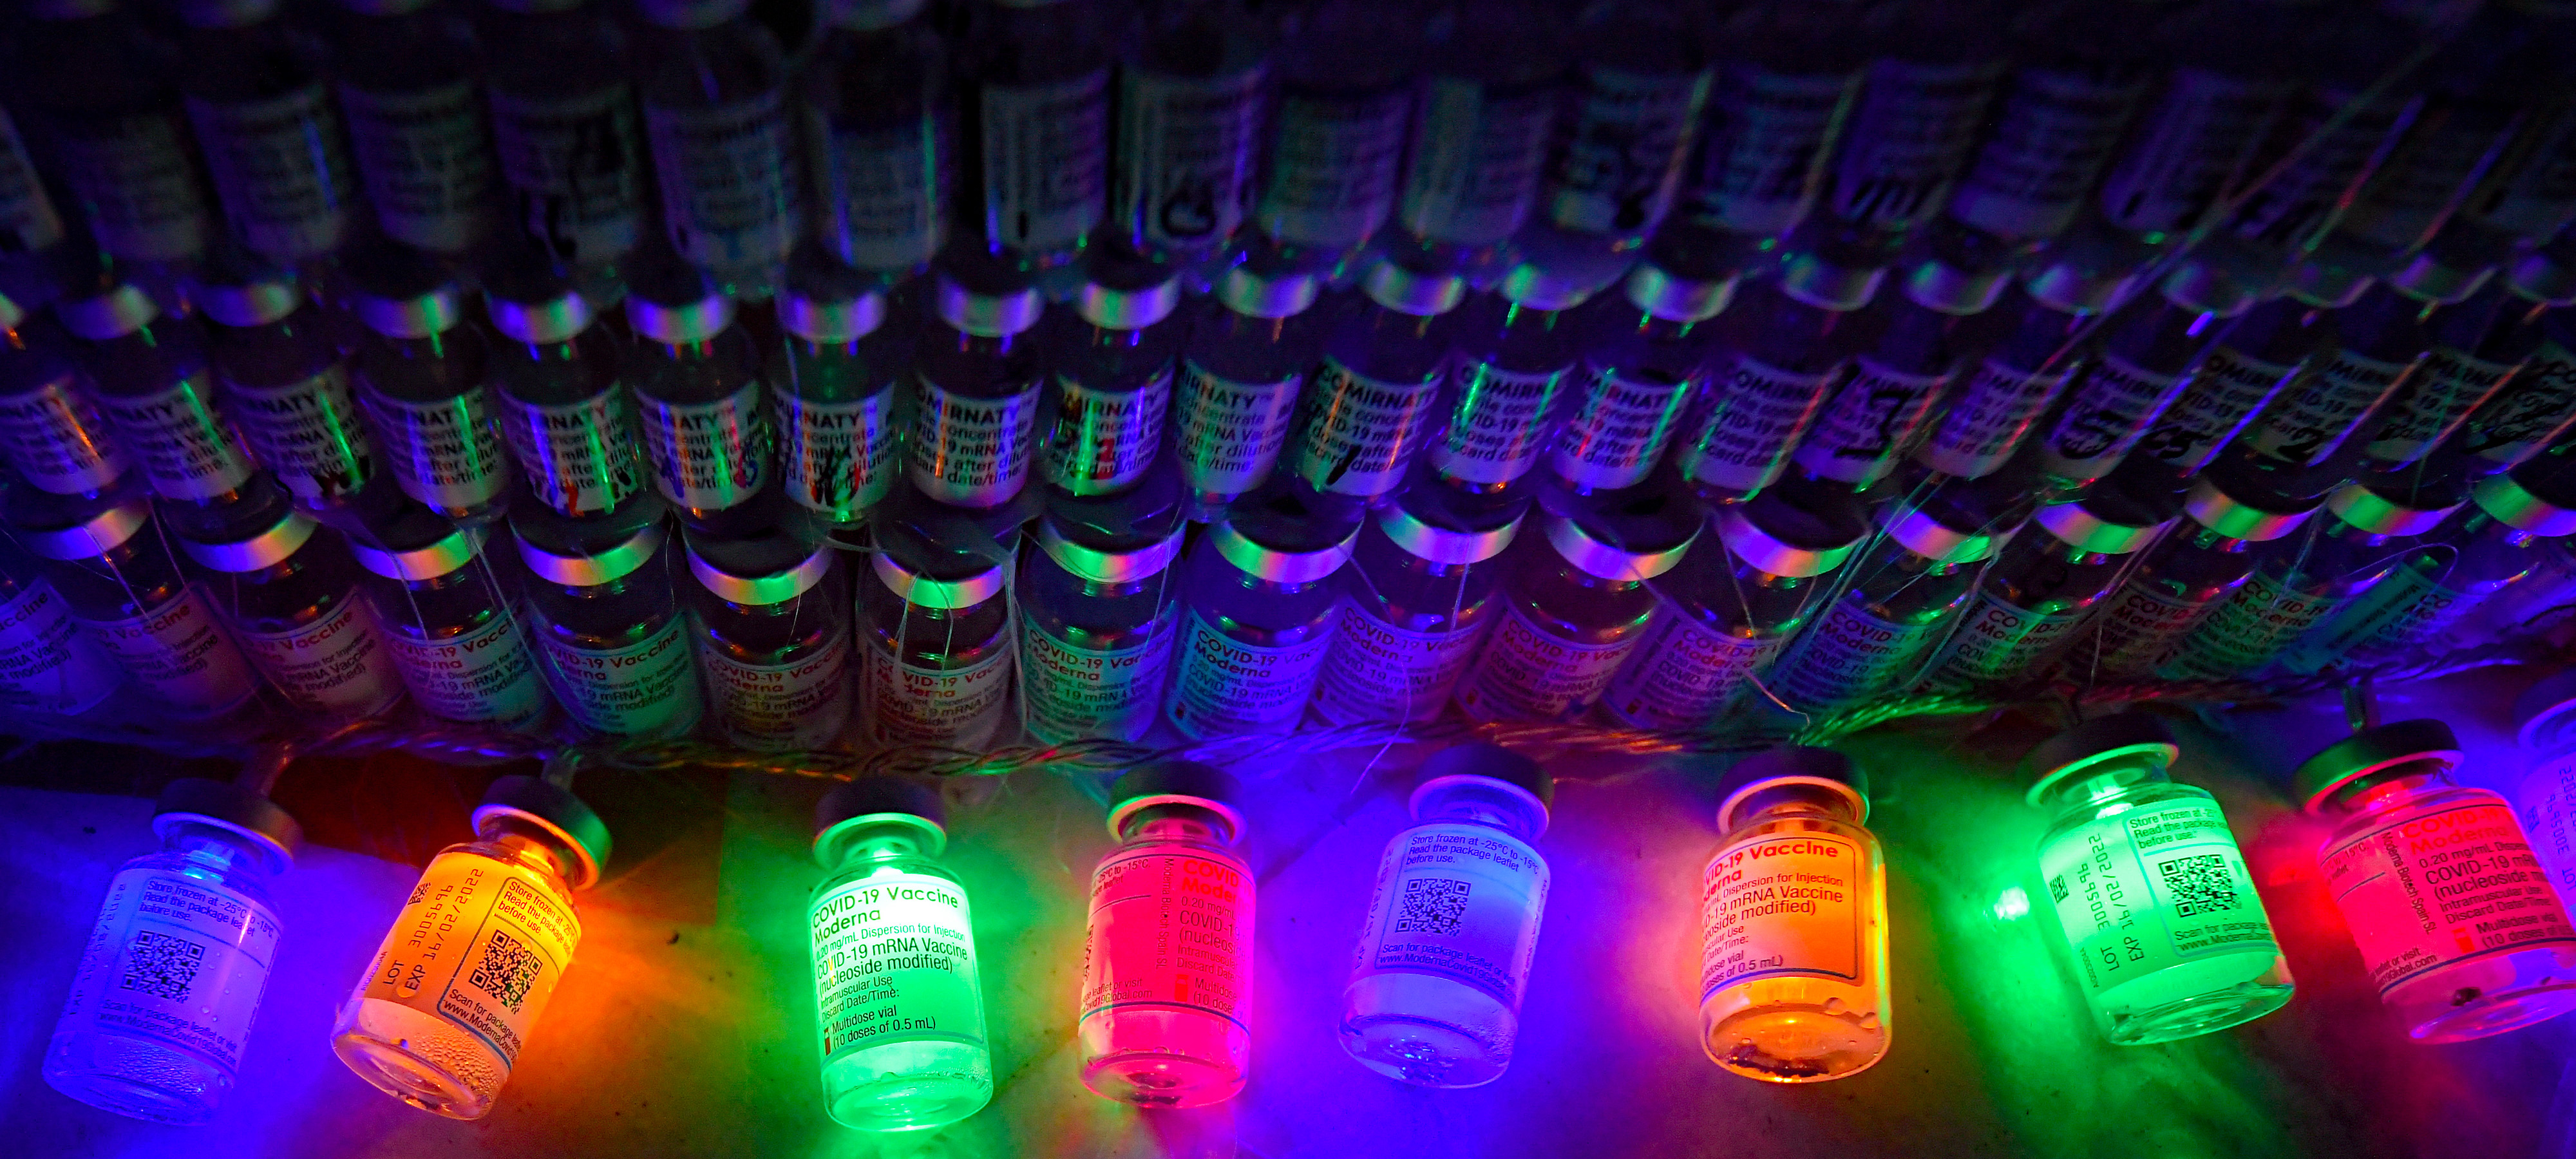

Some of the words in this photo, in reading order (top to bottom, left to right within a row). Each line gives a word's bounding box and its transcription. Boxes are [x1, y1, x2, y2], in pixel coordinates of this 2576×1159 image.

[279, 612, 352, 650] Vaccine
[610, 630, 679, 668] Vaccine
[1030, 630, 1103, 669] COVID-19
[1195, 642, 1271, 677] Moderna
[1198, 630, 1277, 666] COVID-19
[2130, 816, 2158, 829] Store
[2134, 827, 2163, 838] Read
[1408, 844, 1430, 855] Read
[1433, 843, 1448, 852] the
[1450, 845, 1491, 862] package
[1412, 836, 1434, 846] Store
[1437, 834, 1466, 845] frozen
[1468, 837, 1479, 846] at
[1481, 840, 1508, 856] -25°C
[1510, 848, 1518, 860] to
[1750, 841, 1838, 860] Vaccine
[2139, 833, 2173, 849] before
[1124, 859, 1150, 871] -15°C.
[1406, 855, 1434, 865] before
[1436, 854, 1456, 863] use.
[2419, 853, 2448, 869] 0.20
[2425, 856, 2510, 885] COVID-19
[1162, 858, 1174, 895] Moderna
[1723, 876, 1773, 898] Dispersion
[1777, 873, 1793, 883] for
[1796, 872, 1843, 887] Injection
[2434, 871, 2529, 901] (nucleoside
[143, 891, 168, 903] Read
[170, 896, 185, 908] the
[188, 901, 229, 923] package
[147, 880, 173, 894] Store
[174, 885, 206, 902] frozen
[207, 896, 219, 905] at
[220, 901, 247, 918] -25°C
[509, 881, 532, 900] Store
[533, 896, 555, 919] frozen
[556, 916, 564, 926] at
[813, 889, 880, 928] COVID-19
[887, 887, 958, 908] Vaccine
[1181, 896, 1204, 909] 0.20
[1207, 902, 1235, 920] mg/mL
[1730, 887, 1776, 910] mRNA
[1779, 885, 1843, 903] Vaccine
[1741, 900, 1816, 921] modified)
[139, 902, 170, 916] before
[171, 909, 193, 922] use.
[498, 900, 526, 923] before
[527, 919, 541, 936] use.
[504, 891, 527, 910] Read
[527, 905, 540, 919] the
[540, 917, 564, 943] package
[1160, 898, 1171, 928] Biotech
[1180, 910, 1240, 940] COVID-19
[2446, 903, 2495, 924] Discard
[383, 959, 404, 985] LOT
[408, 885, 453, 948] 3005696
[404, 964, 426, 990] EXP
[422, 869, 484, 960] 16/02/2022
[815, 909, 881, 947] Moderna
[830, 931, 859, 951] mg/mL
[862, 923, 915, 939] Dispersion
[918, 923, 931, 934] for
[934, 924, 966, 943] Injection
[1727, 925, 1744, 936] Use
[2175, 928, 2202, 940] Scan
[2481, 934, 2504, 948] (10
[1157, 932, 1170, 956] Spain
[1383, 944, 1403, 954] Scan
[1406, 943, 1420, 952] for
[1422, 945, 1463, 960] package
[1727, 950, 1744, 964] vial
[2124, 936, 2145, 961] EXP
[817, 944, 868, 979] COVID-19
[872, 938, 920, 956] mRNA
[922, 938, 967, 960] Vaccine
[1155, 958, 1168, 968] SL
[1177, 957, 1214, 974] Discard
[1726, 966, 1736, 977] of
[1738, 959, 1756, 973] 0.5
[1760, 955, 1783, 968] mL)
[2101, 946, 2120, 971] LOT
[819, 959, 882, 998] (nucleoside
[887, 953, 953, 974] modified)
[1092, 982, 1112, 996] leaflet
[1124, 977, 1142, 987] visit
[820, 980, 871, 1010] Intramuscular
[873, 975, 893, 986] Use
[1195, 977, 1237, 1002] Multidose
[450, 989, 473, 1008] Scan
[474, 1003, 488, 1015] for
[486, 1013, 513, 1039] package
[822, 1001, 845, 1022] Discard
[847, 988, 900, 1008] Date/Time:
[1193, 991, 1209, 1006] (10
[1213, 999, 1235, 1016] doses
[832, 1011, 875, 1034] Multidose
[878, 1005, 898, 1017] vial
[833, 1037, 846, 1050] (10
[848, 1026, 876, 1042] doses
[879, 1021, 889, 1033] of
[893, 1018, 912, 1031] 0.5
[915, 1016, 936, 1030] mL)
